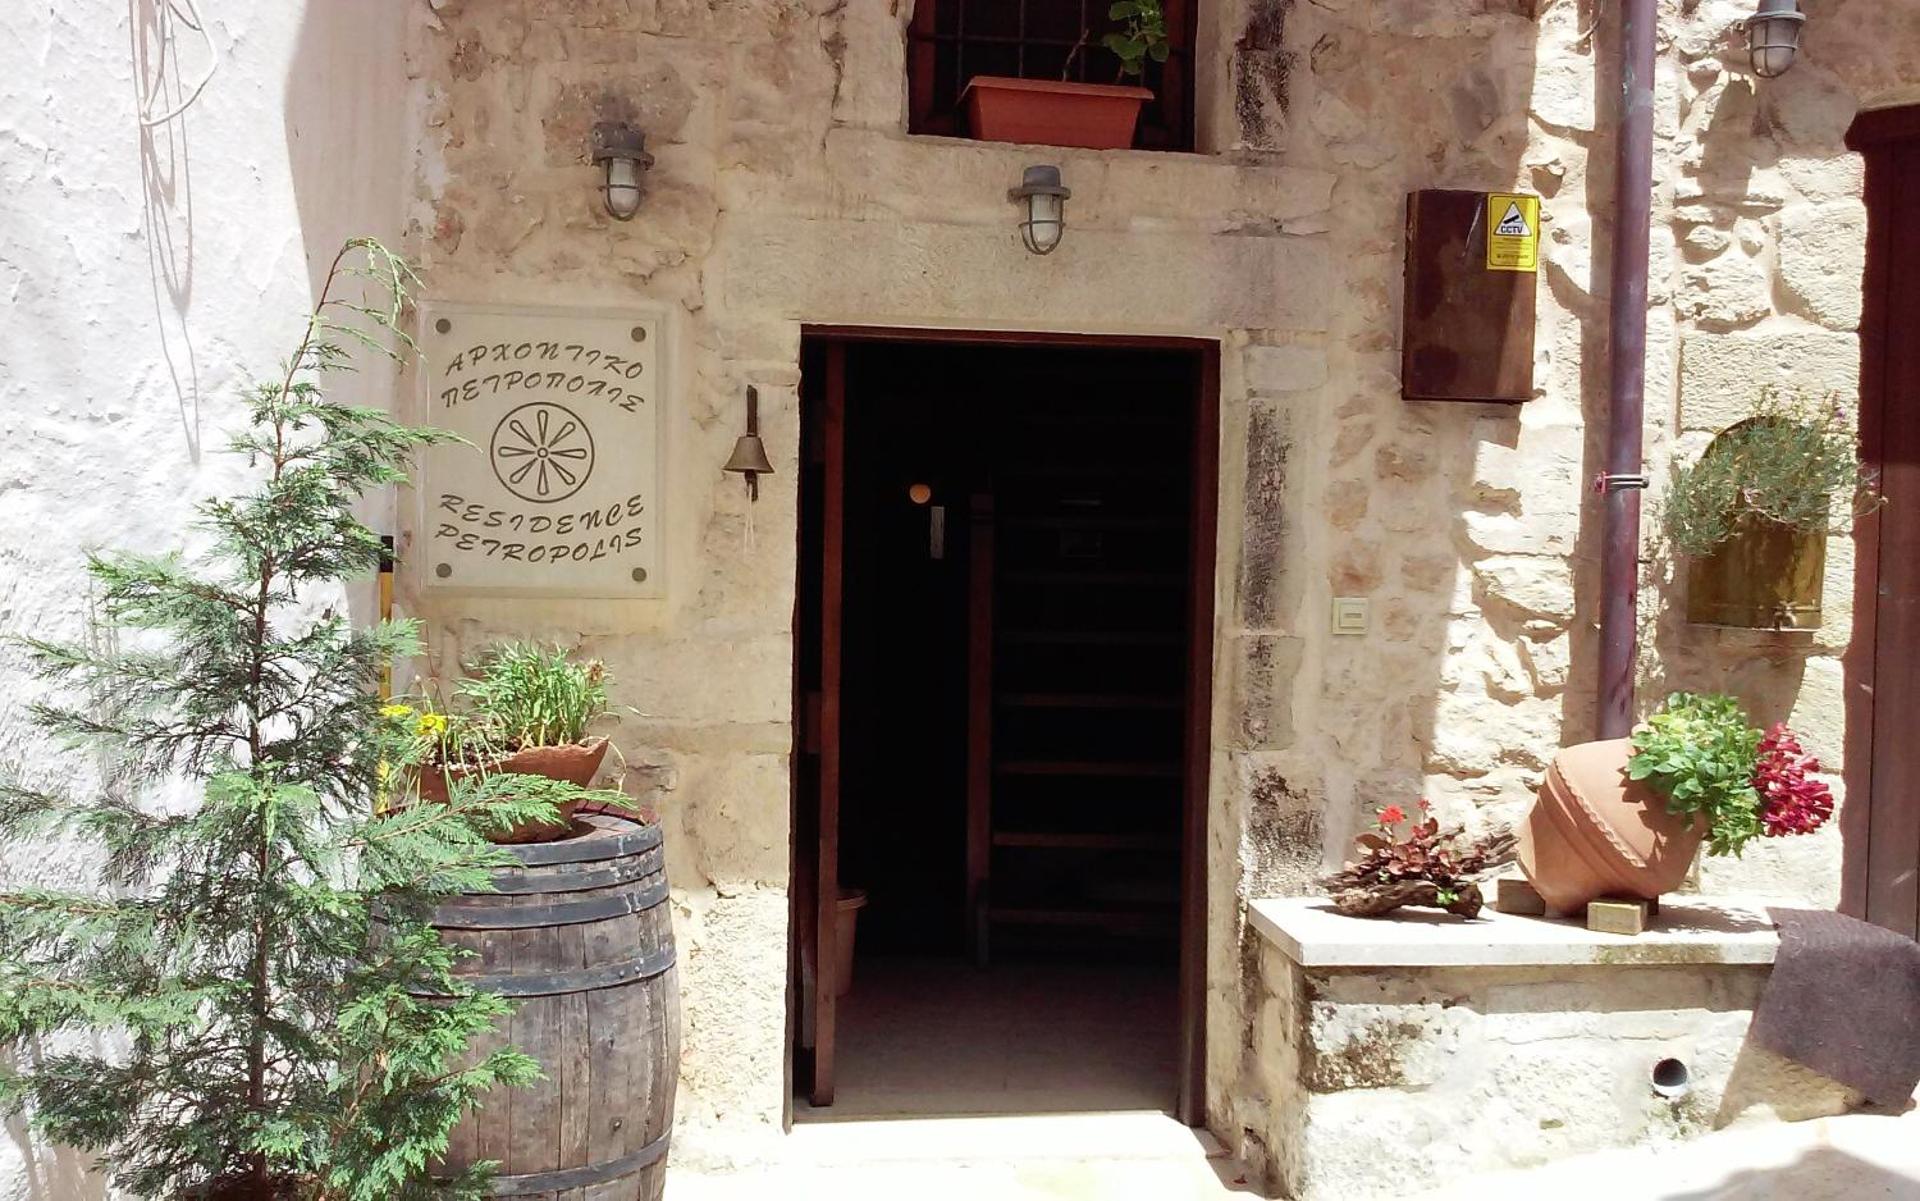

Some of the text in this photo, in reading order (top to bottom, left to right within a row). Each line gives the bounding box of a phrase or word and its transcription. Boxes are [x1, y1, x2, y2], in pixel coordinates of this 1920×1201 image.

[445, 342, 643, 379] ΑΡΧΟΝΤΙΚΟ
[441, 370, 645, 413] ΠΕΤΡΟΠΟΛΙΣ
[440, 494, 644, 535] RESIDENCE
[434, 523, 642, 564] PETROPOLIS
